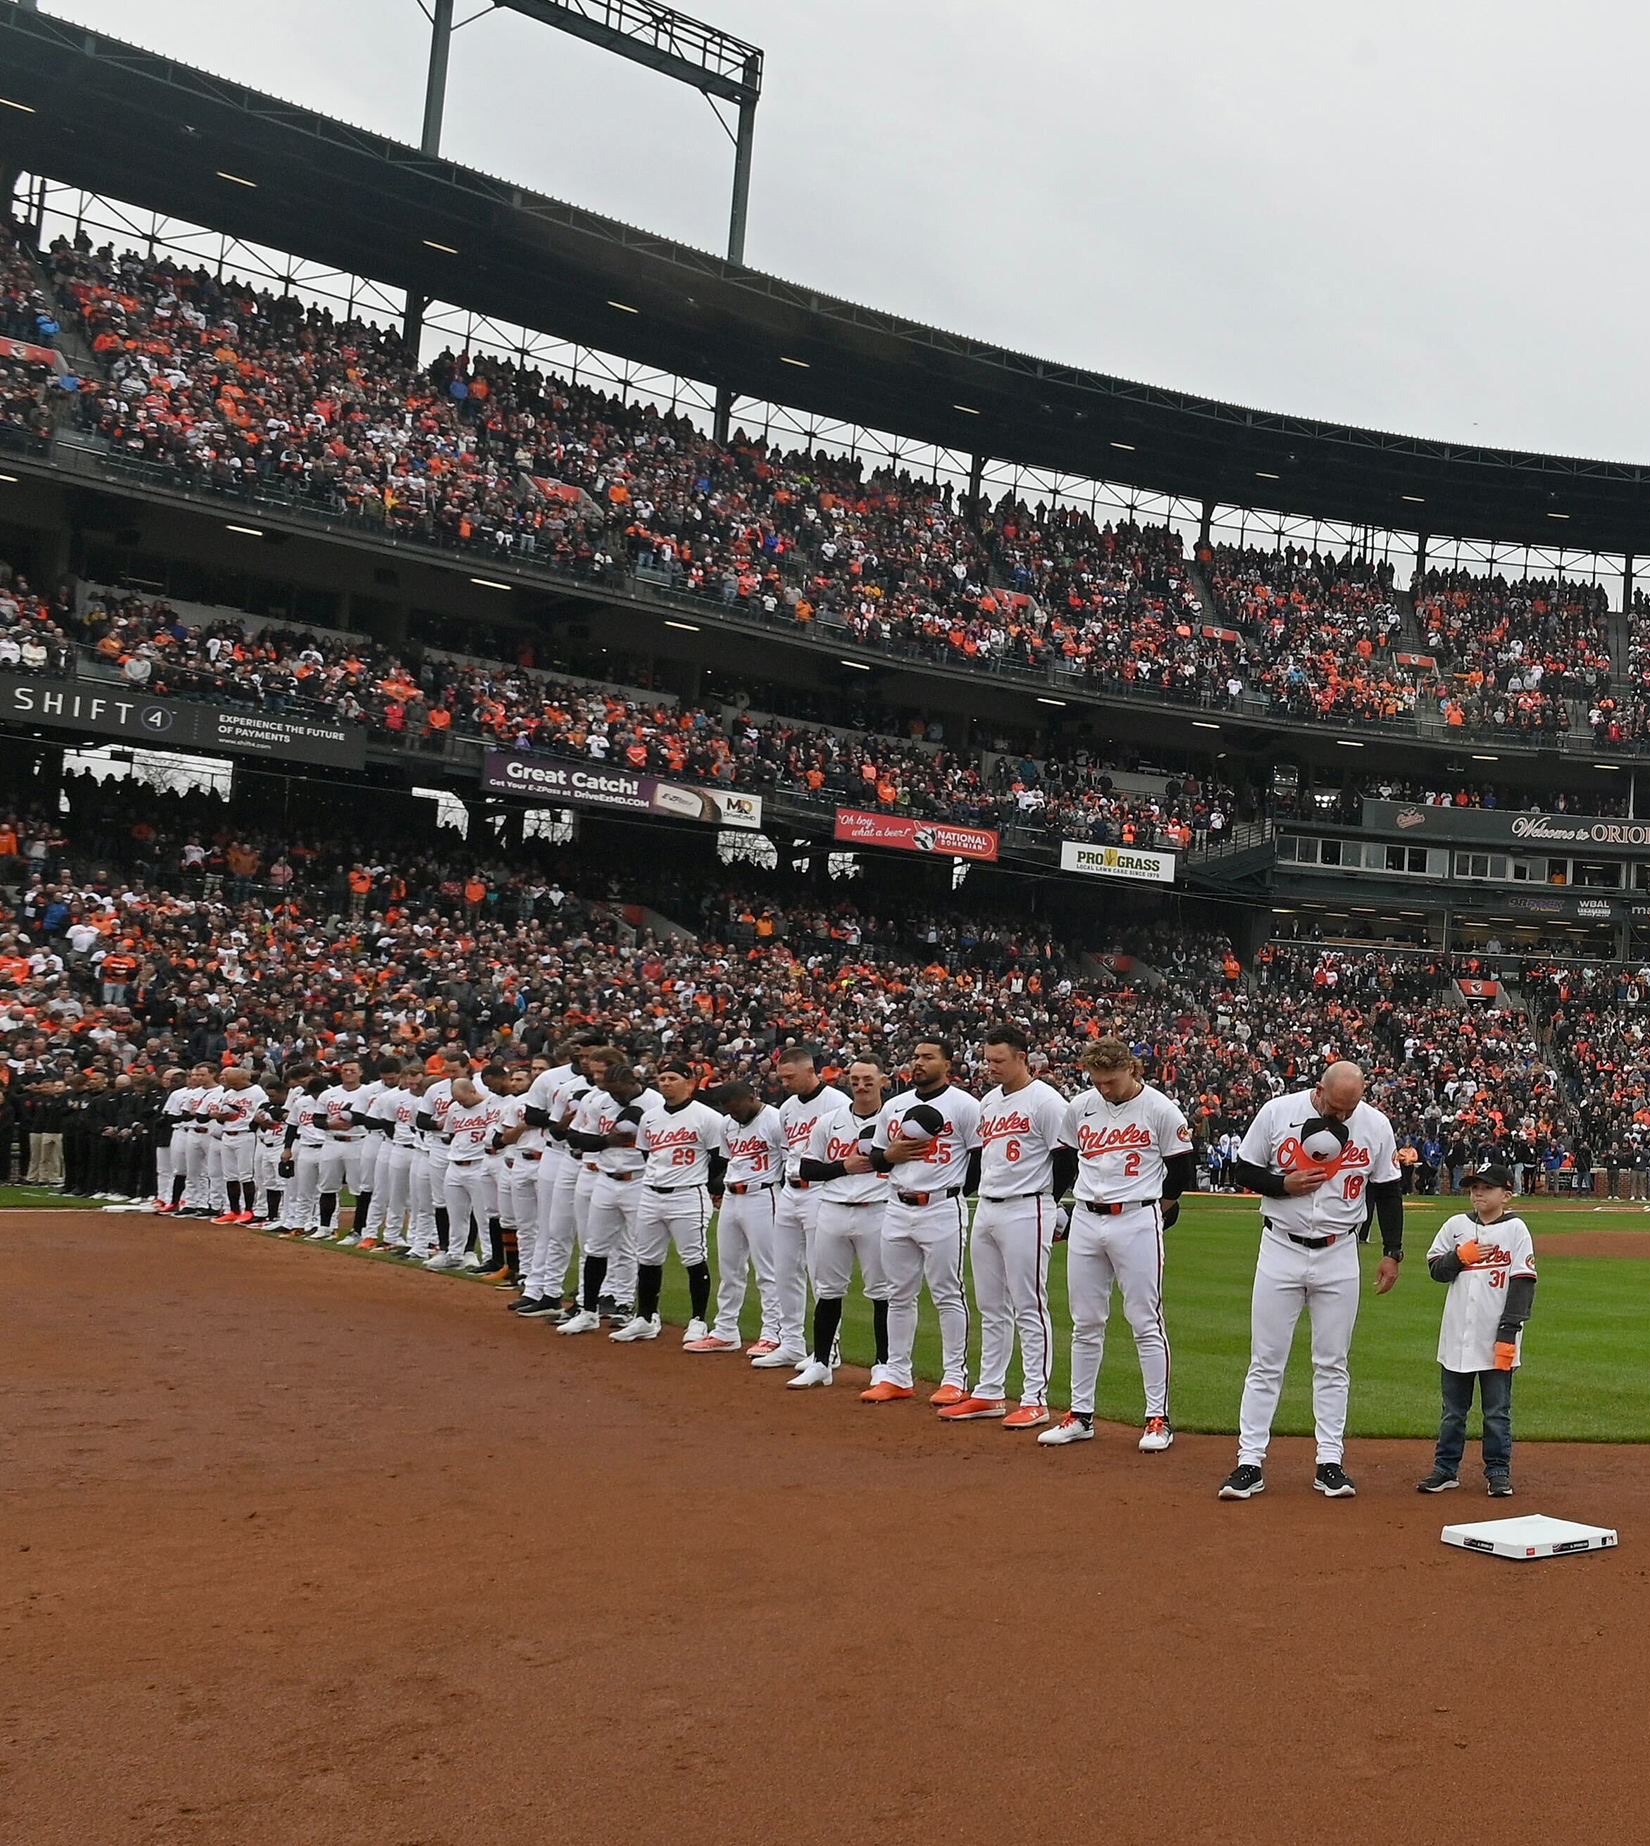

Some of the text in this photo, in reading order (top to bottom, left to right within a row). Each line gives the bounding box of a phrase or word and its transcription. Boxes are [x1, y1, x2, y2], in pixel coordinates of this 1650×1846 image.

[14, 687, 163, 727] SHIFT 4
[218, 714, 345, 741] EXPERIENCE THE FUTURE
[218, 725, 291, 743] OF PAYMENTS
[218, 738, 272, 749] www.shift4.com
[489, 778, 506, 787] Get
[507, 780, 527, 791] Your
[528, 785, 561, 796] E-ZPass
[506, 762, 640, 795] Great Catch!
[851, 827, 875, 837] what
[876, 829, 883, 837] a
[937, 830, 988, 846] NATIONAL
[1511, 816, 1574, 838] Welcome
[1575, 828, 1591, 841] to
[1077, 851, 1160, 872] PRO GRASS
[1129, 870, 1146, 878] SINCE
[1579, 899, 1610, 908] WBAL
[976, 1111, 1030, 1145] Orioles
[645, 1127, 699, 1151] Orioles
[727, 1135, 769, 1155] rioles
[1078, 1123, 1152, 1155] Orioles
[672, 1148, 695, 1166] 29
[1006, 1140, 1021, 1162] 6
[750, 1153, 769, 1172] 31
[1124, 1153, 1141, 1177] 2
[1342, 1174, 1364, 1200] 18
[1488, 1269, 1506, 1289] 31
